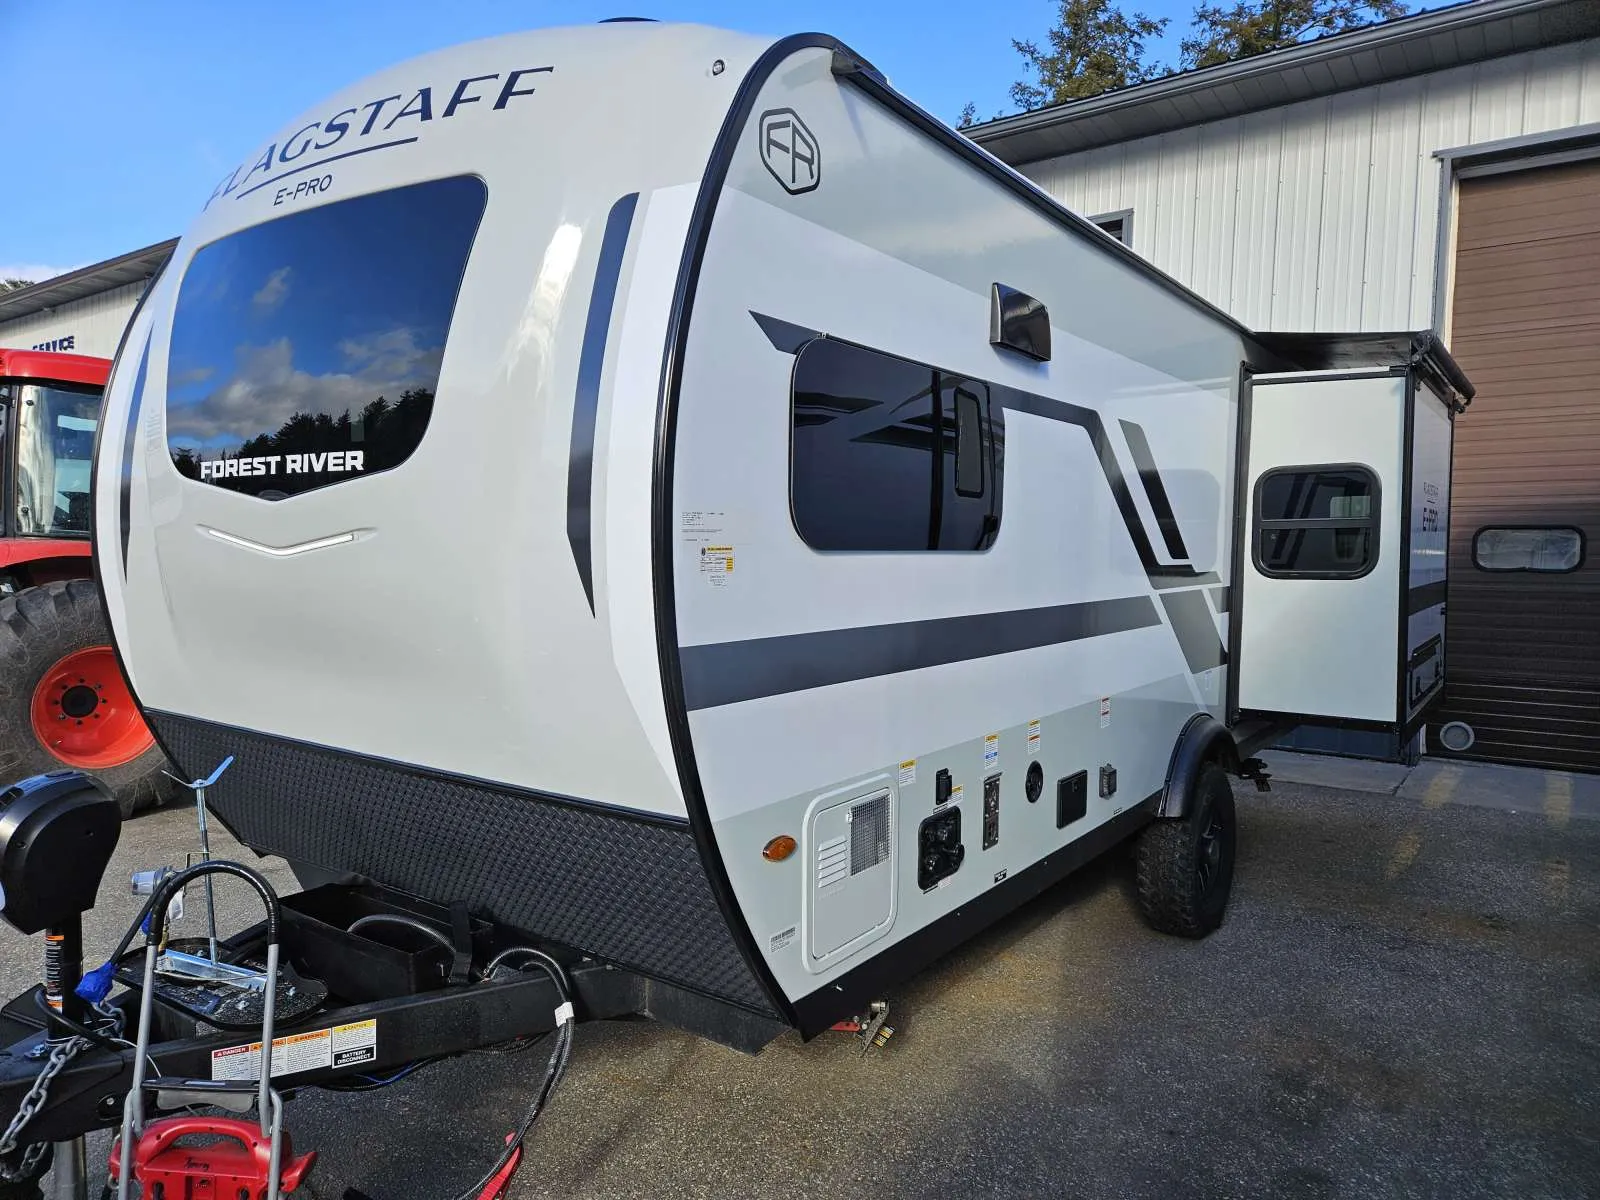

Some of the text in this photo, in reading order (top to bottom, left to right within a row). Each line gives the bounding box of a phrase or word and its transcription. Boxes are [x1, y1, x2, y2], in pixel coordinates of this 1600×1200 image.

[202, 65, 554, 213] FLAGSTAFF
[273, 174, 333, 207] E-PRO
[200, 450, 365, 479] FOREST RIVER
[222, 1047, 246, 1056] DANGER
[337, 1053, 371, 1065] DISCONNECT
[342, 1049, 366, 1059] BATTERY
